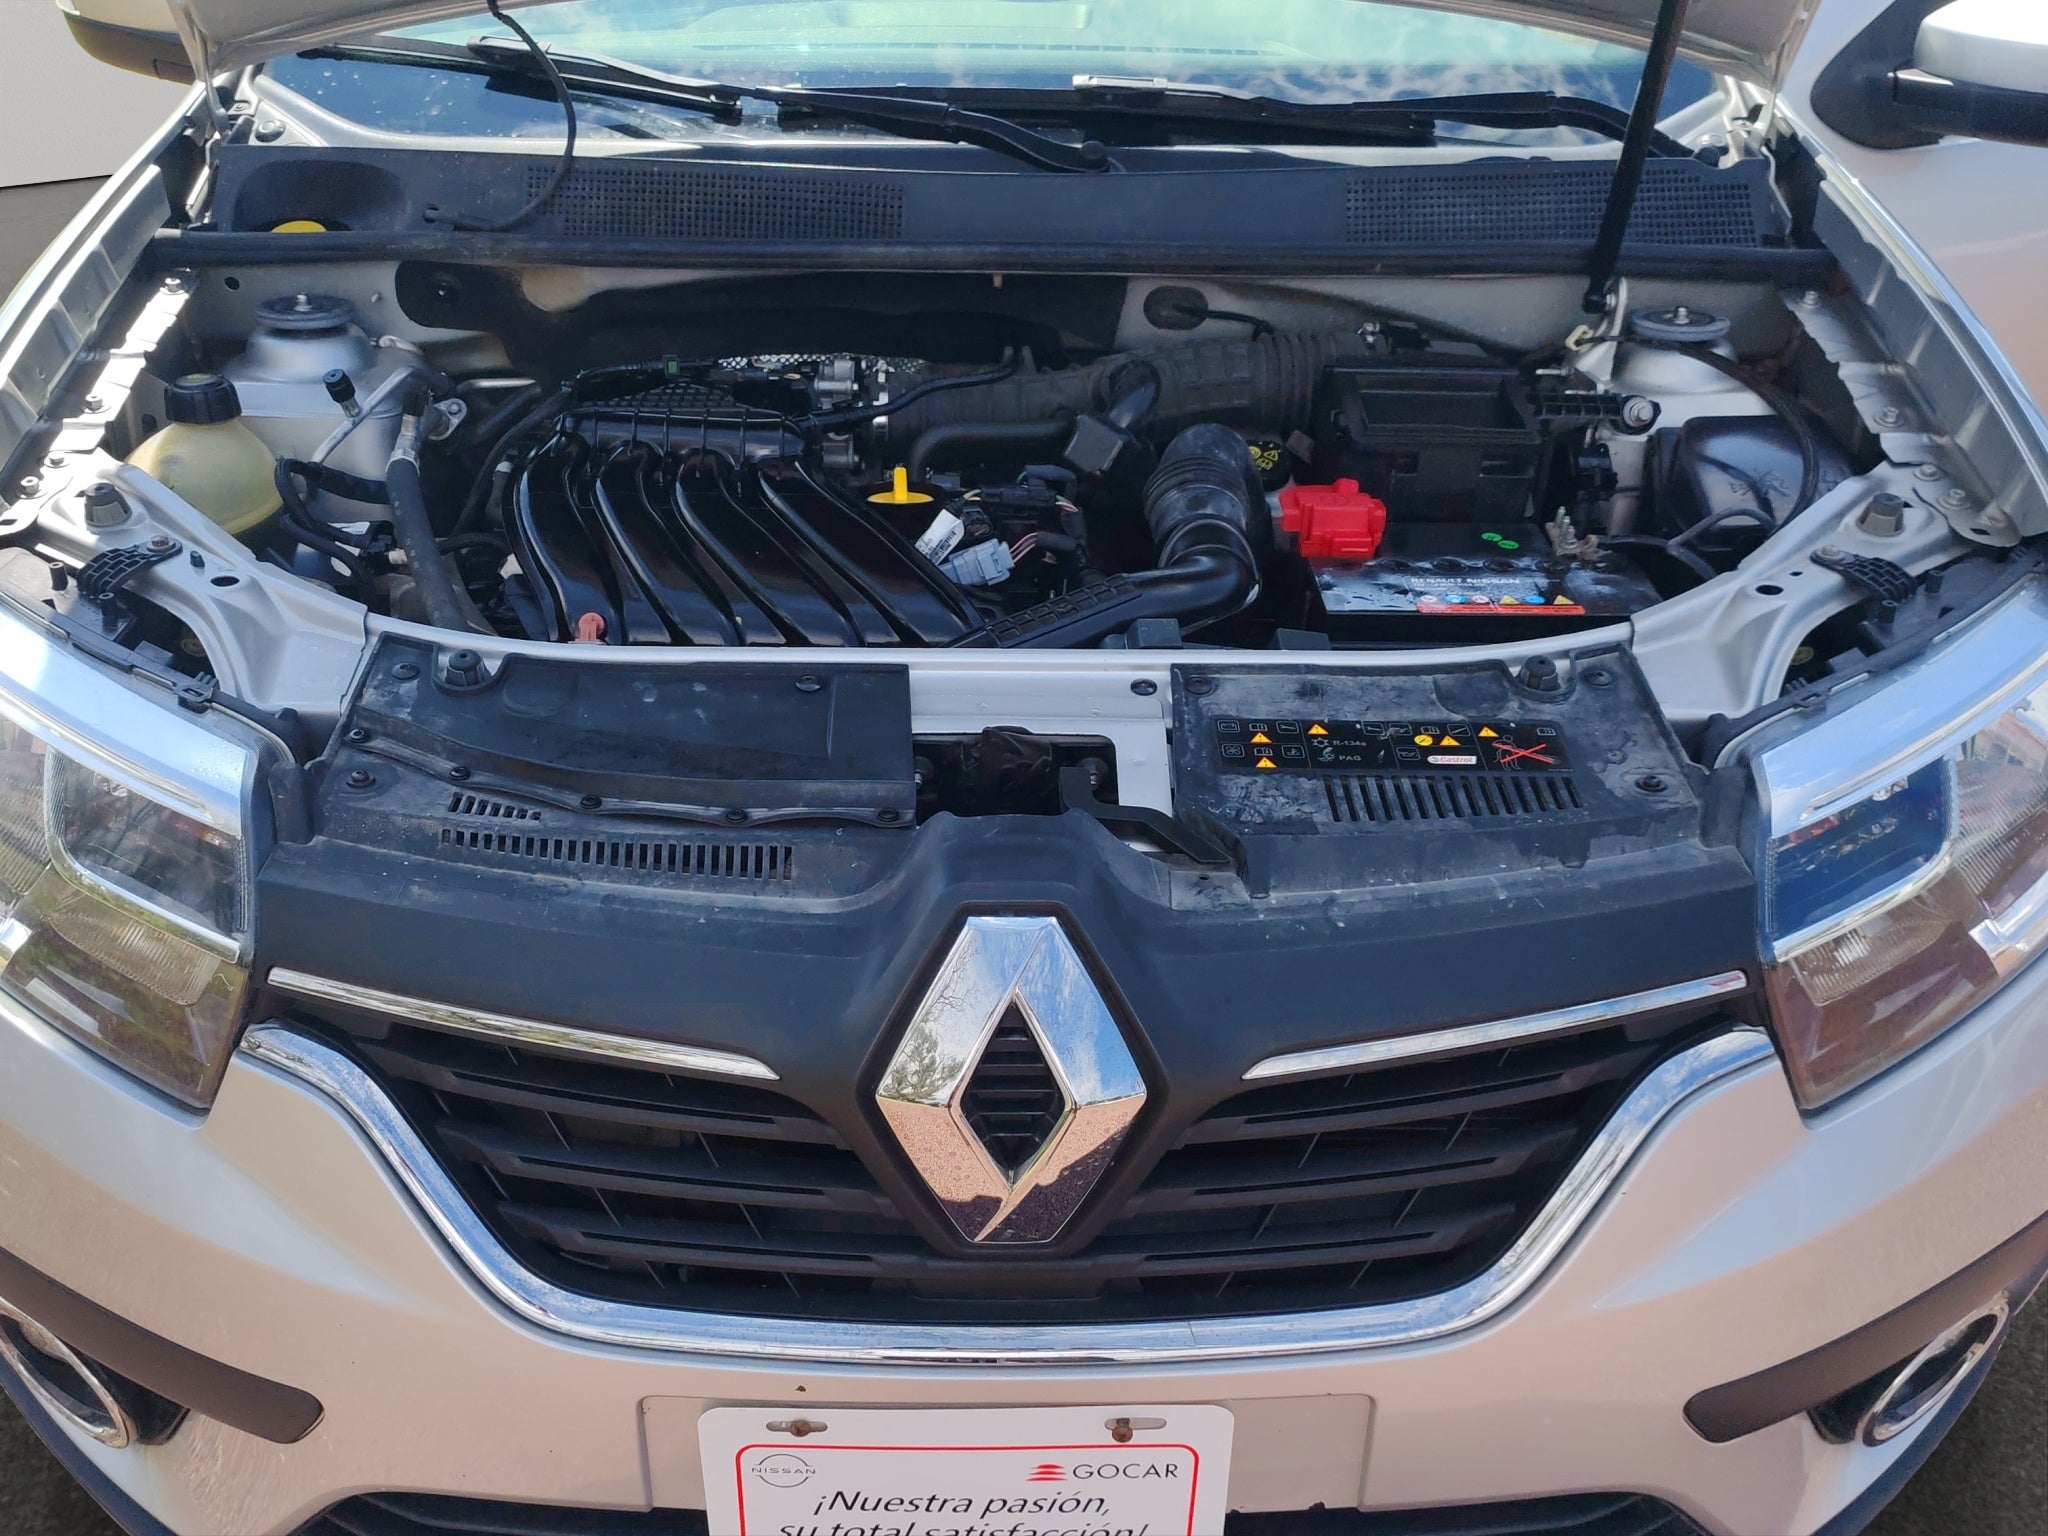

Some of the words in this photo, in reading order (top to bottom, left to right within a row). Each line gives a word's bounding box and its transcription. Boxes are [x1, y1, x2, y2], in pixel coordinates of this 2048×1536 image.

[751, 1466, 816, 1475] NISSAN
[1072, 1463, 1179, 1480] GOCAR
[813, 1490, 973, 1516] ¡Nuestra
[979, 1491, 1110, 1520] pasión,
